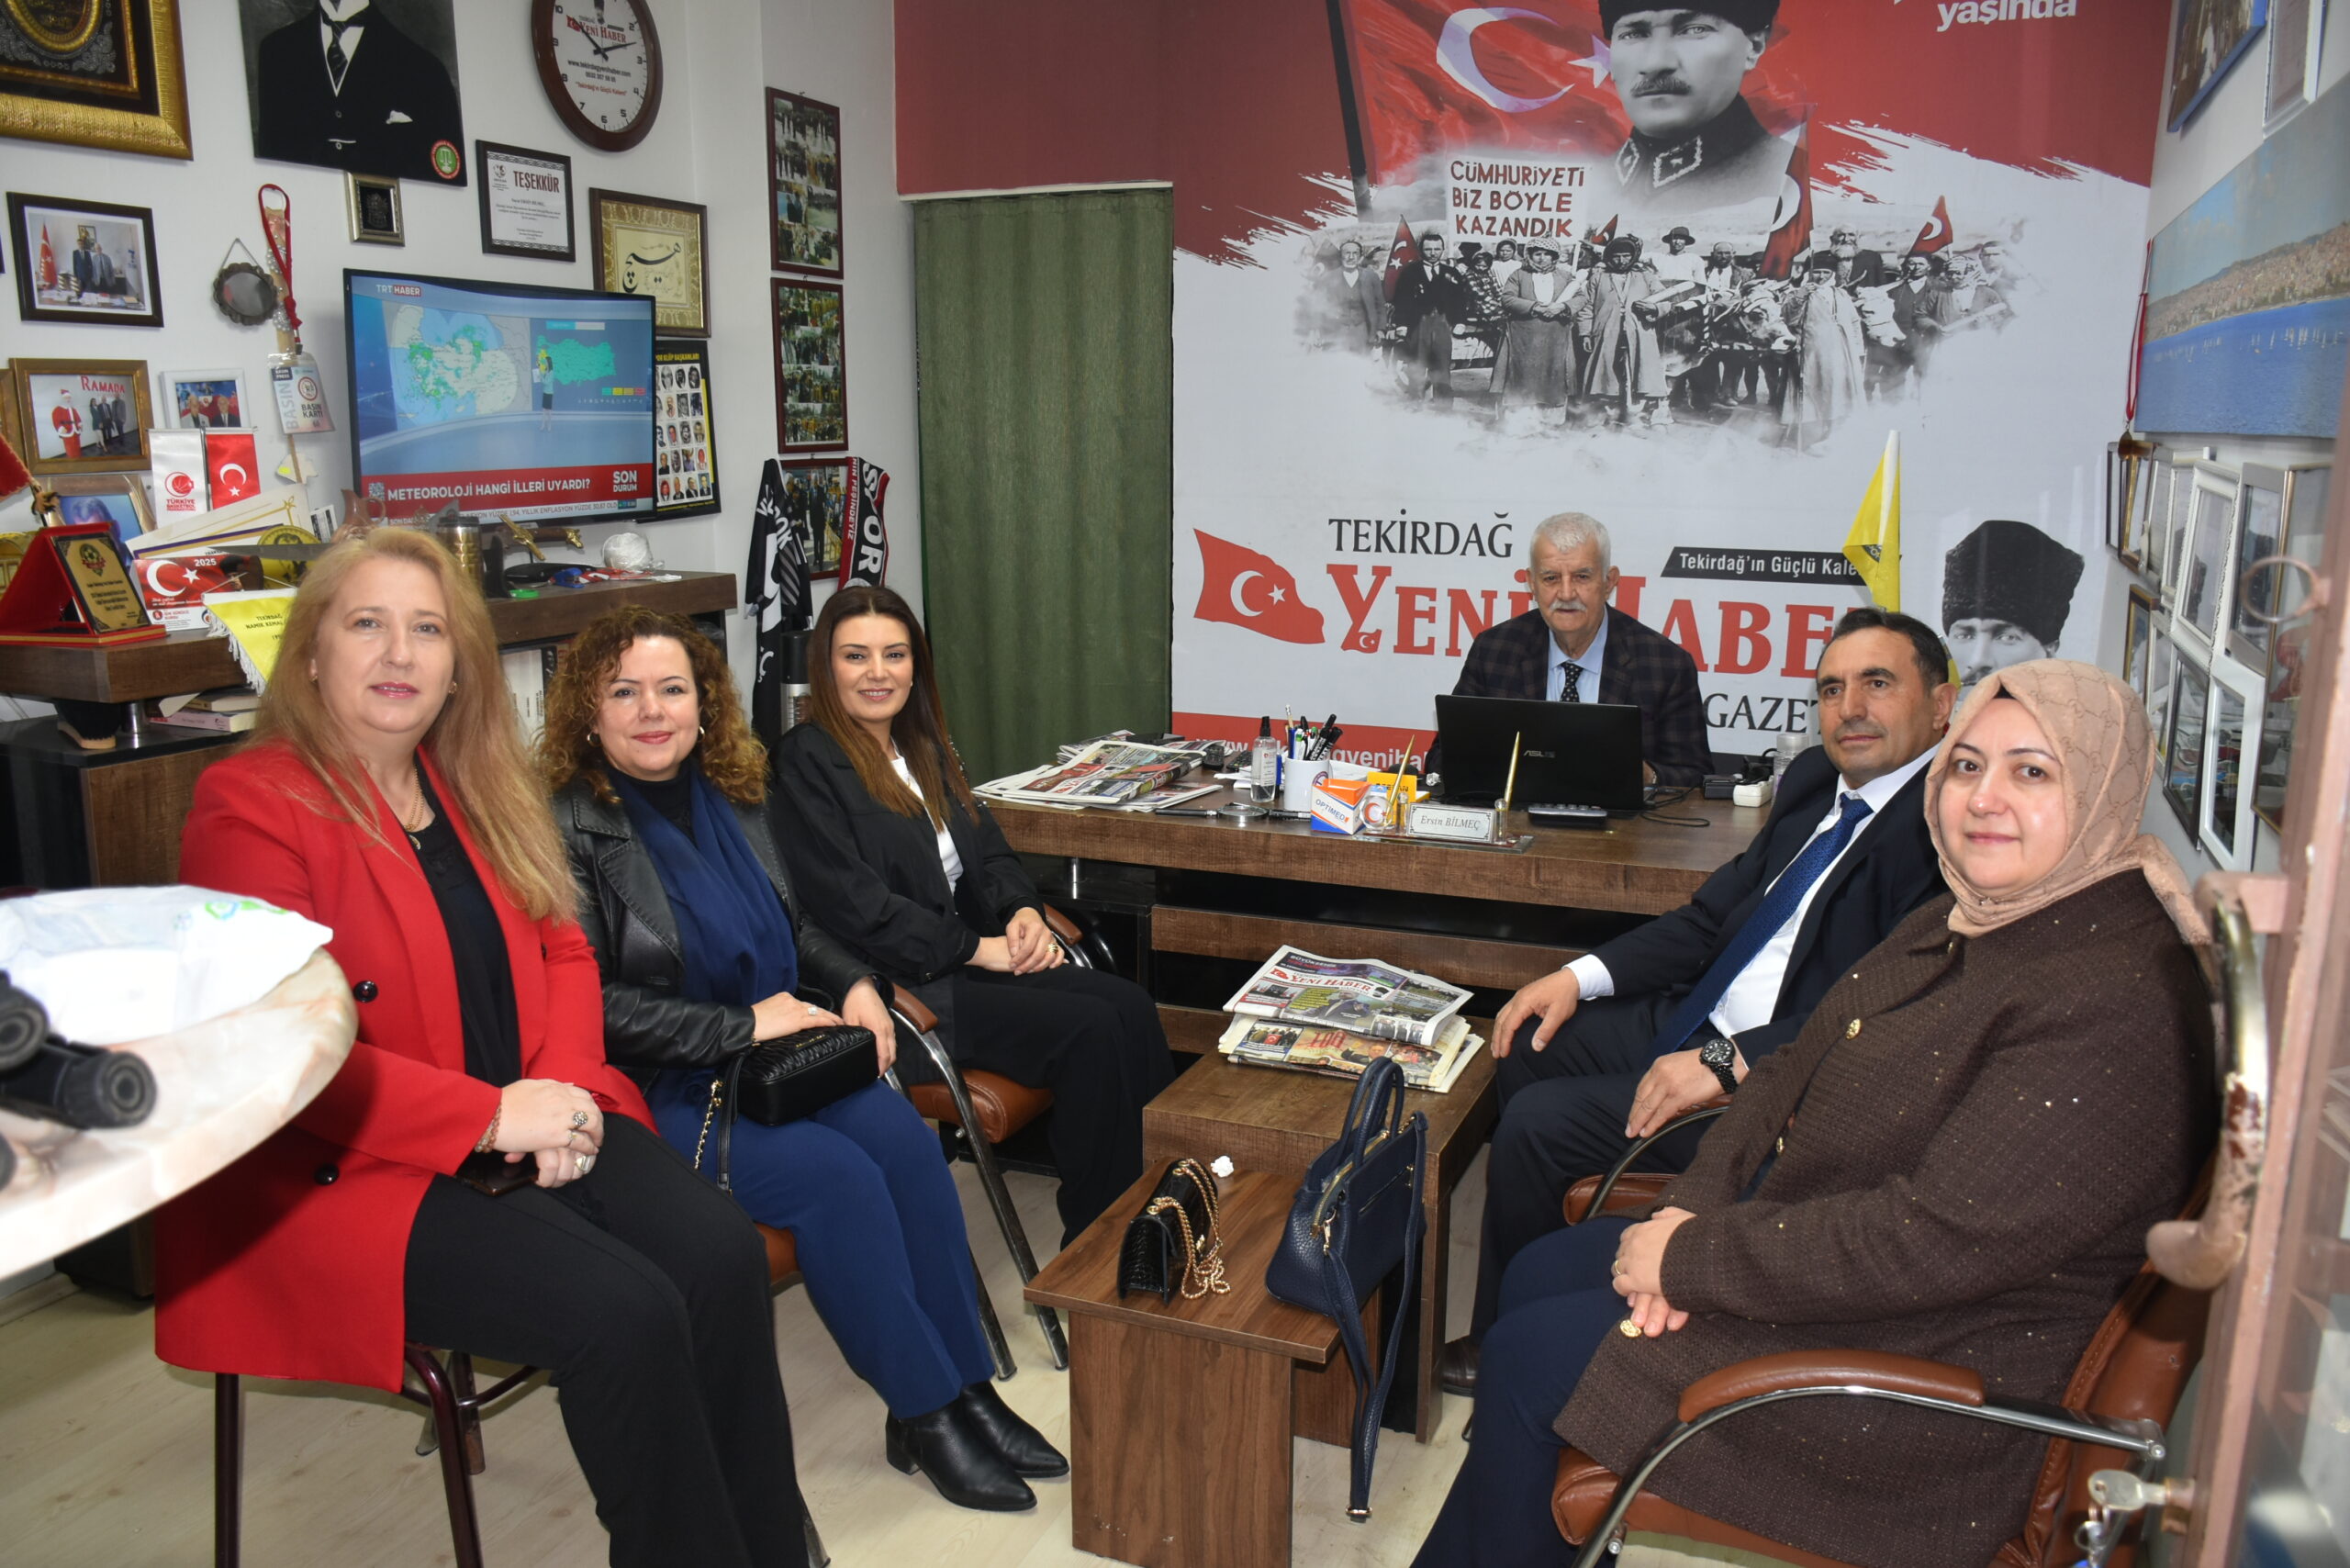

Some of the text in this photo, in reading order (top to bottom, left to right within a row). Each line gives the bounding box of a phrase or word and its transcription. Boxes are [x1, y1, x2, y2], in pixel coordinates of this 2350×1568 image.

[1936, 0, 2076, 32] yaşında
[600, 26, 626, 43] HABER
[512, 170, 560, 193] TEŞEKKÜR
[1450, 160, 1584, 186] CÜMHURİYETİ
[1452, 186, 1572, 212] BİZ BÖYLE
[1456, 214, 1572, 238] KAZANDIK
[376, 285, 420, 296] TRT HABER
[279, 383, 299, 429] BASIN
[613, 470, 637, 484] SON
[613, 484, 638, 493] DURUM
[387, 478, 590, 501] METEOROLOJİ HANGİ İLLERİ UYARDI?
[1328, 509, 1513, 558] TEKİRDAĞ
[194, 558, 217, 567] 2025
[1771, 556, 1816, 577] Güçlü
[1822, 558, 1857, 577] Kale
[1616, 576, 1870, 680] ABE
[1703, 693, 1819, 734] GAZE
[1420, 815, 1481, 830] Ersin BİLMEÇ
[1292, 975, 1372, 991] YENİ HABER
